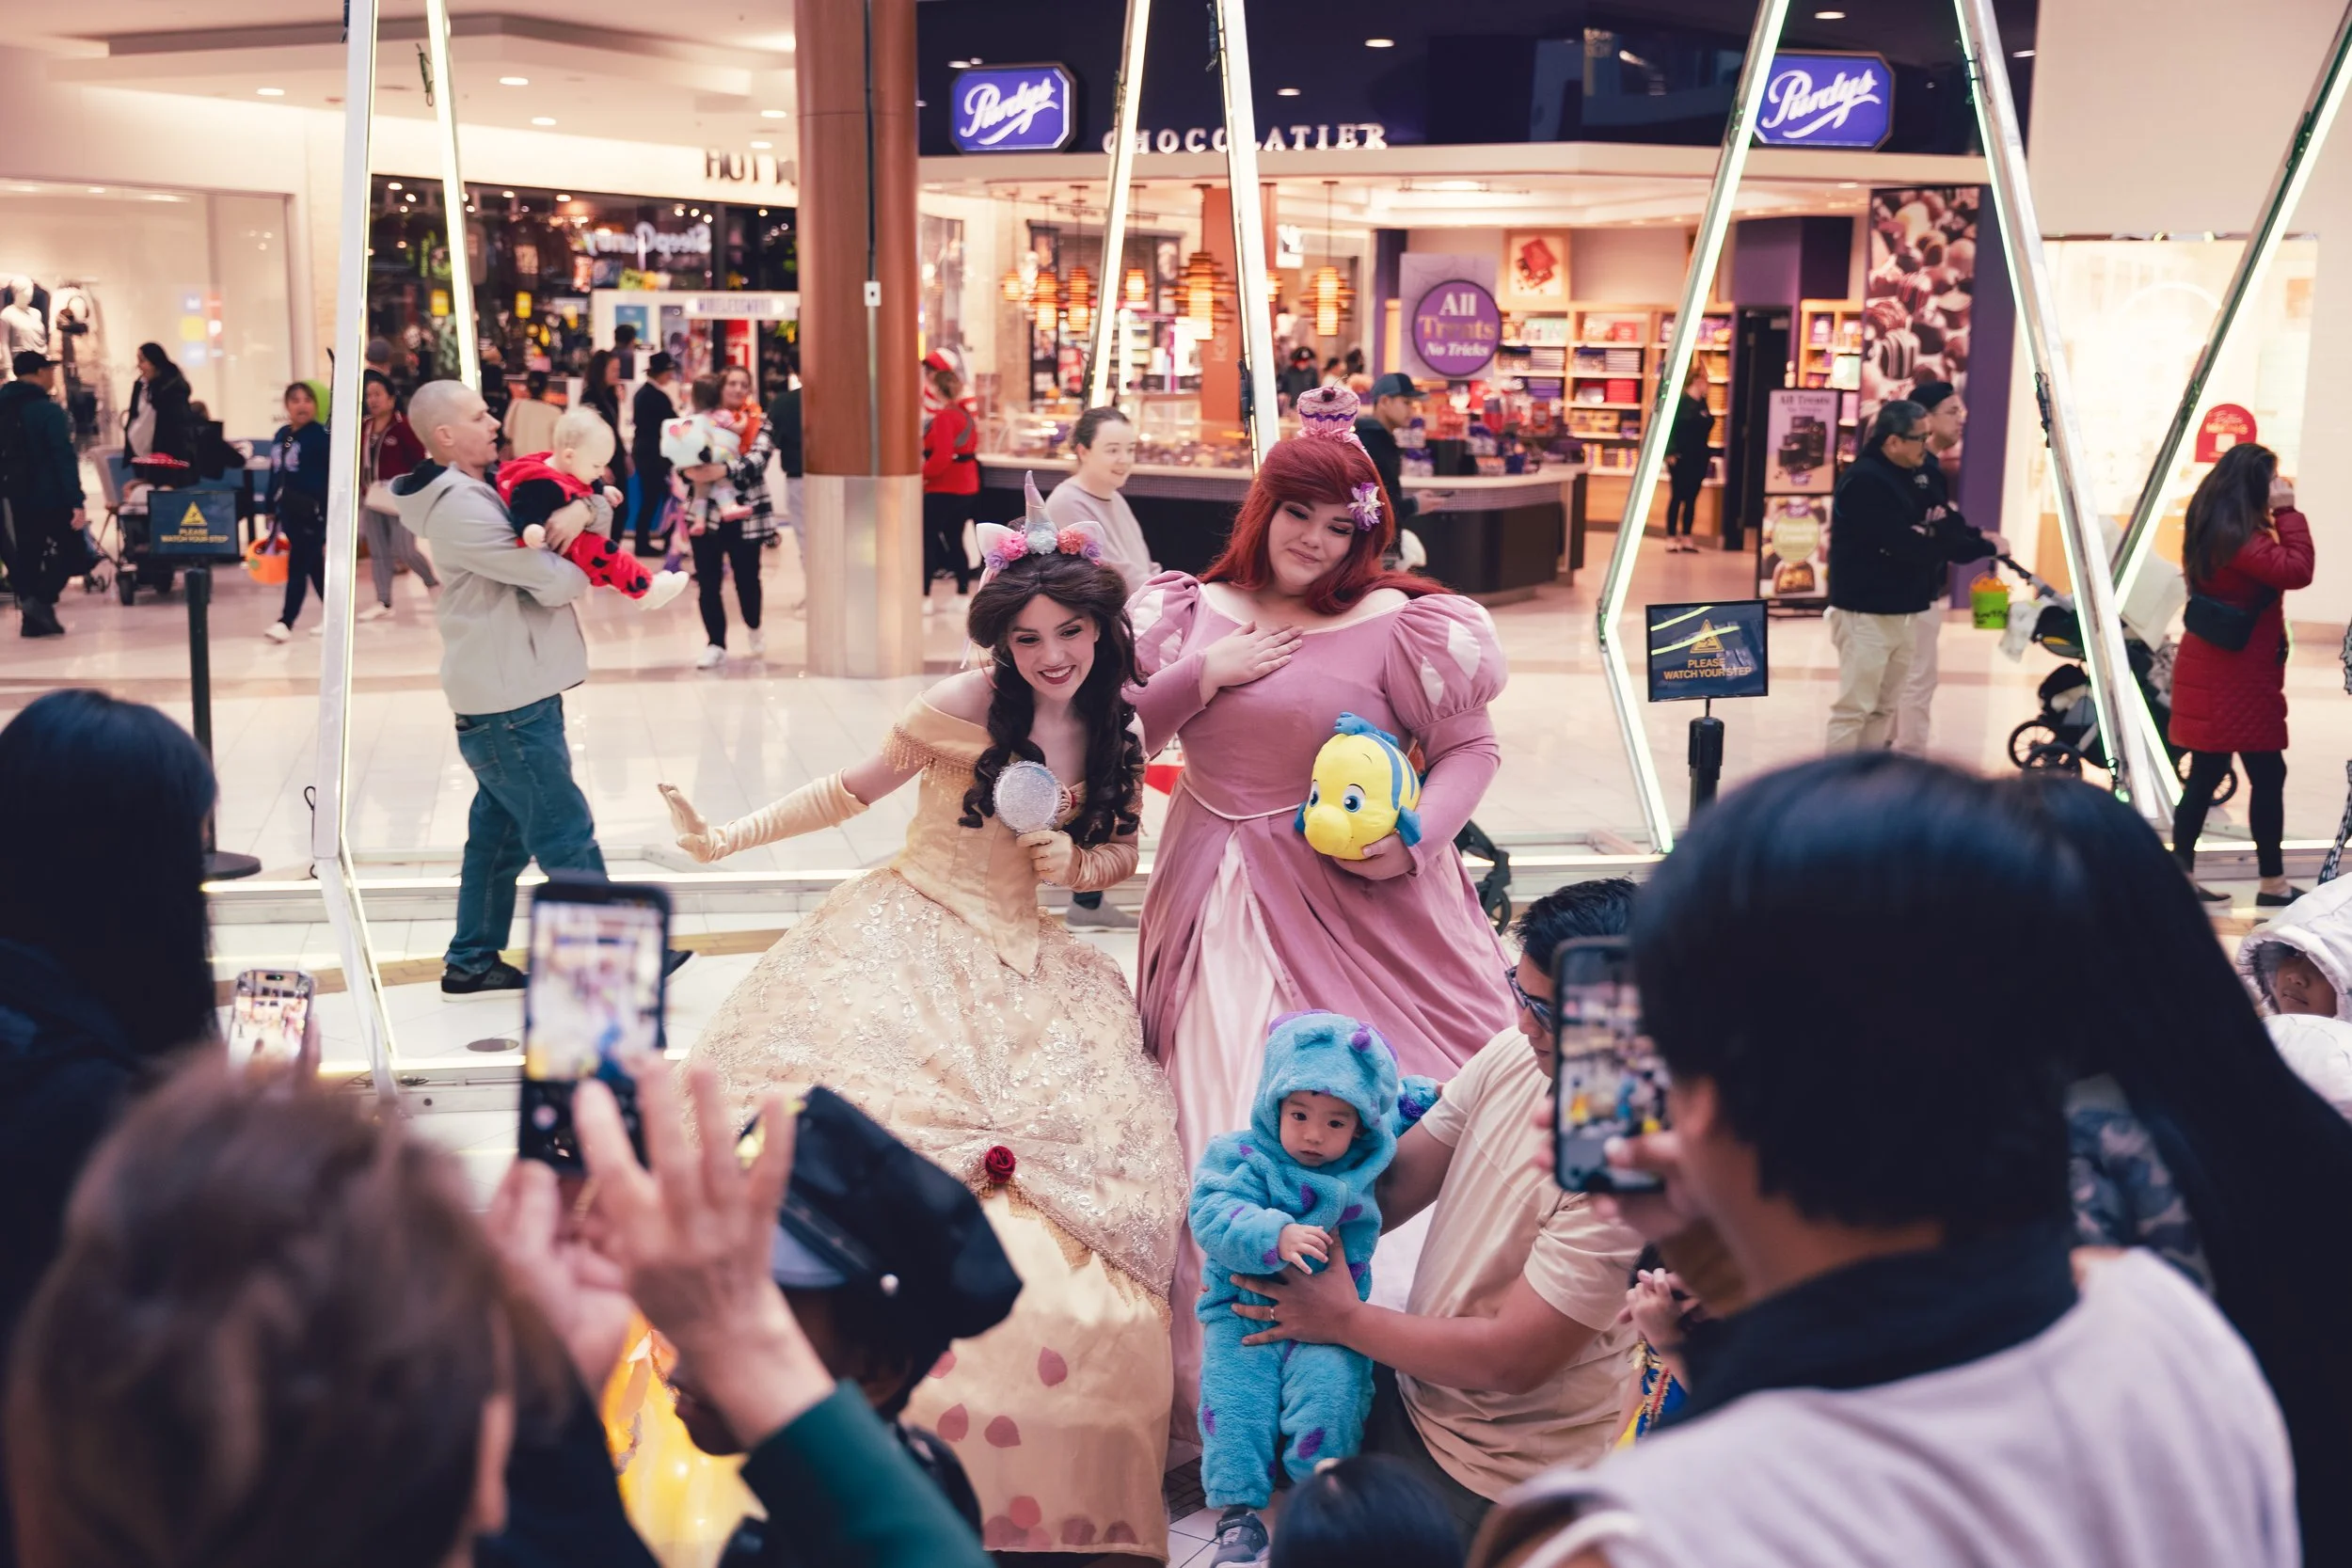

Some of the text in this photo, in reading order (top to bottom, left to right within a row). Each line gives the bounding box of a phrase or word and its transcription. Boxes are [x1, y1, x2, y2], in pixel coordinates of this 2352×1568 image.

[960, 77, 1059, 145] Purdys
[1760, 69, 1881, 138] Purdys
[1102, 123, 1388, 154] CHOCOATIER
[1438, 292, 1477, 317] All
[1418, 315, 1496, 341] Treats
[1425, 341, 1489, 356] No Tricks
[179, 528, 209, 536] PLEASE
[1663, 666, 1752, 680] WATCH YOUR STEP
[1688, 657, 1724, 668] PLEASE
